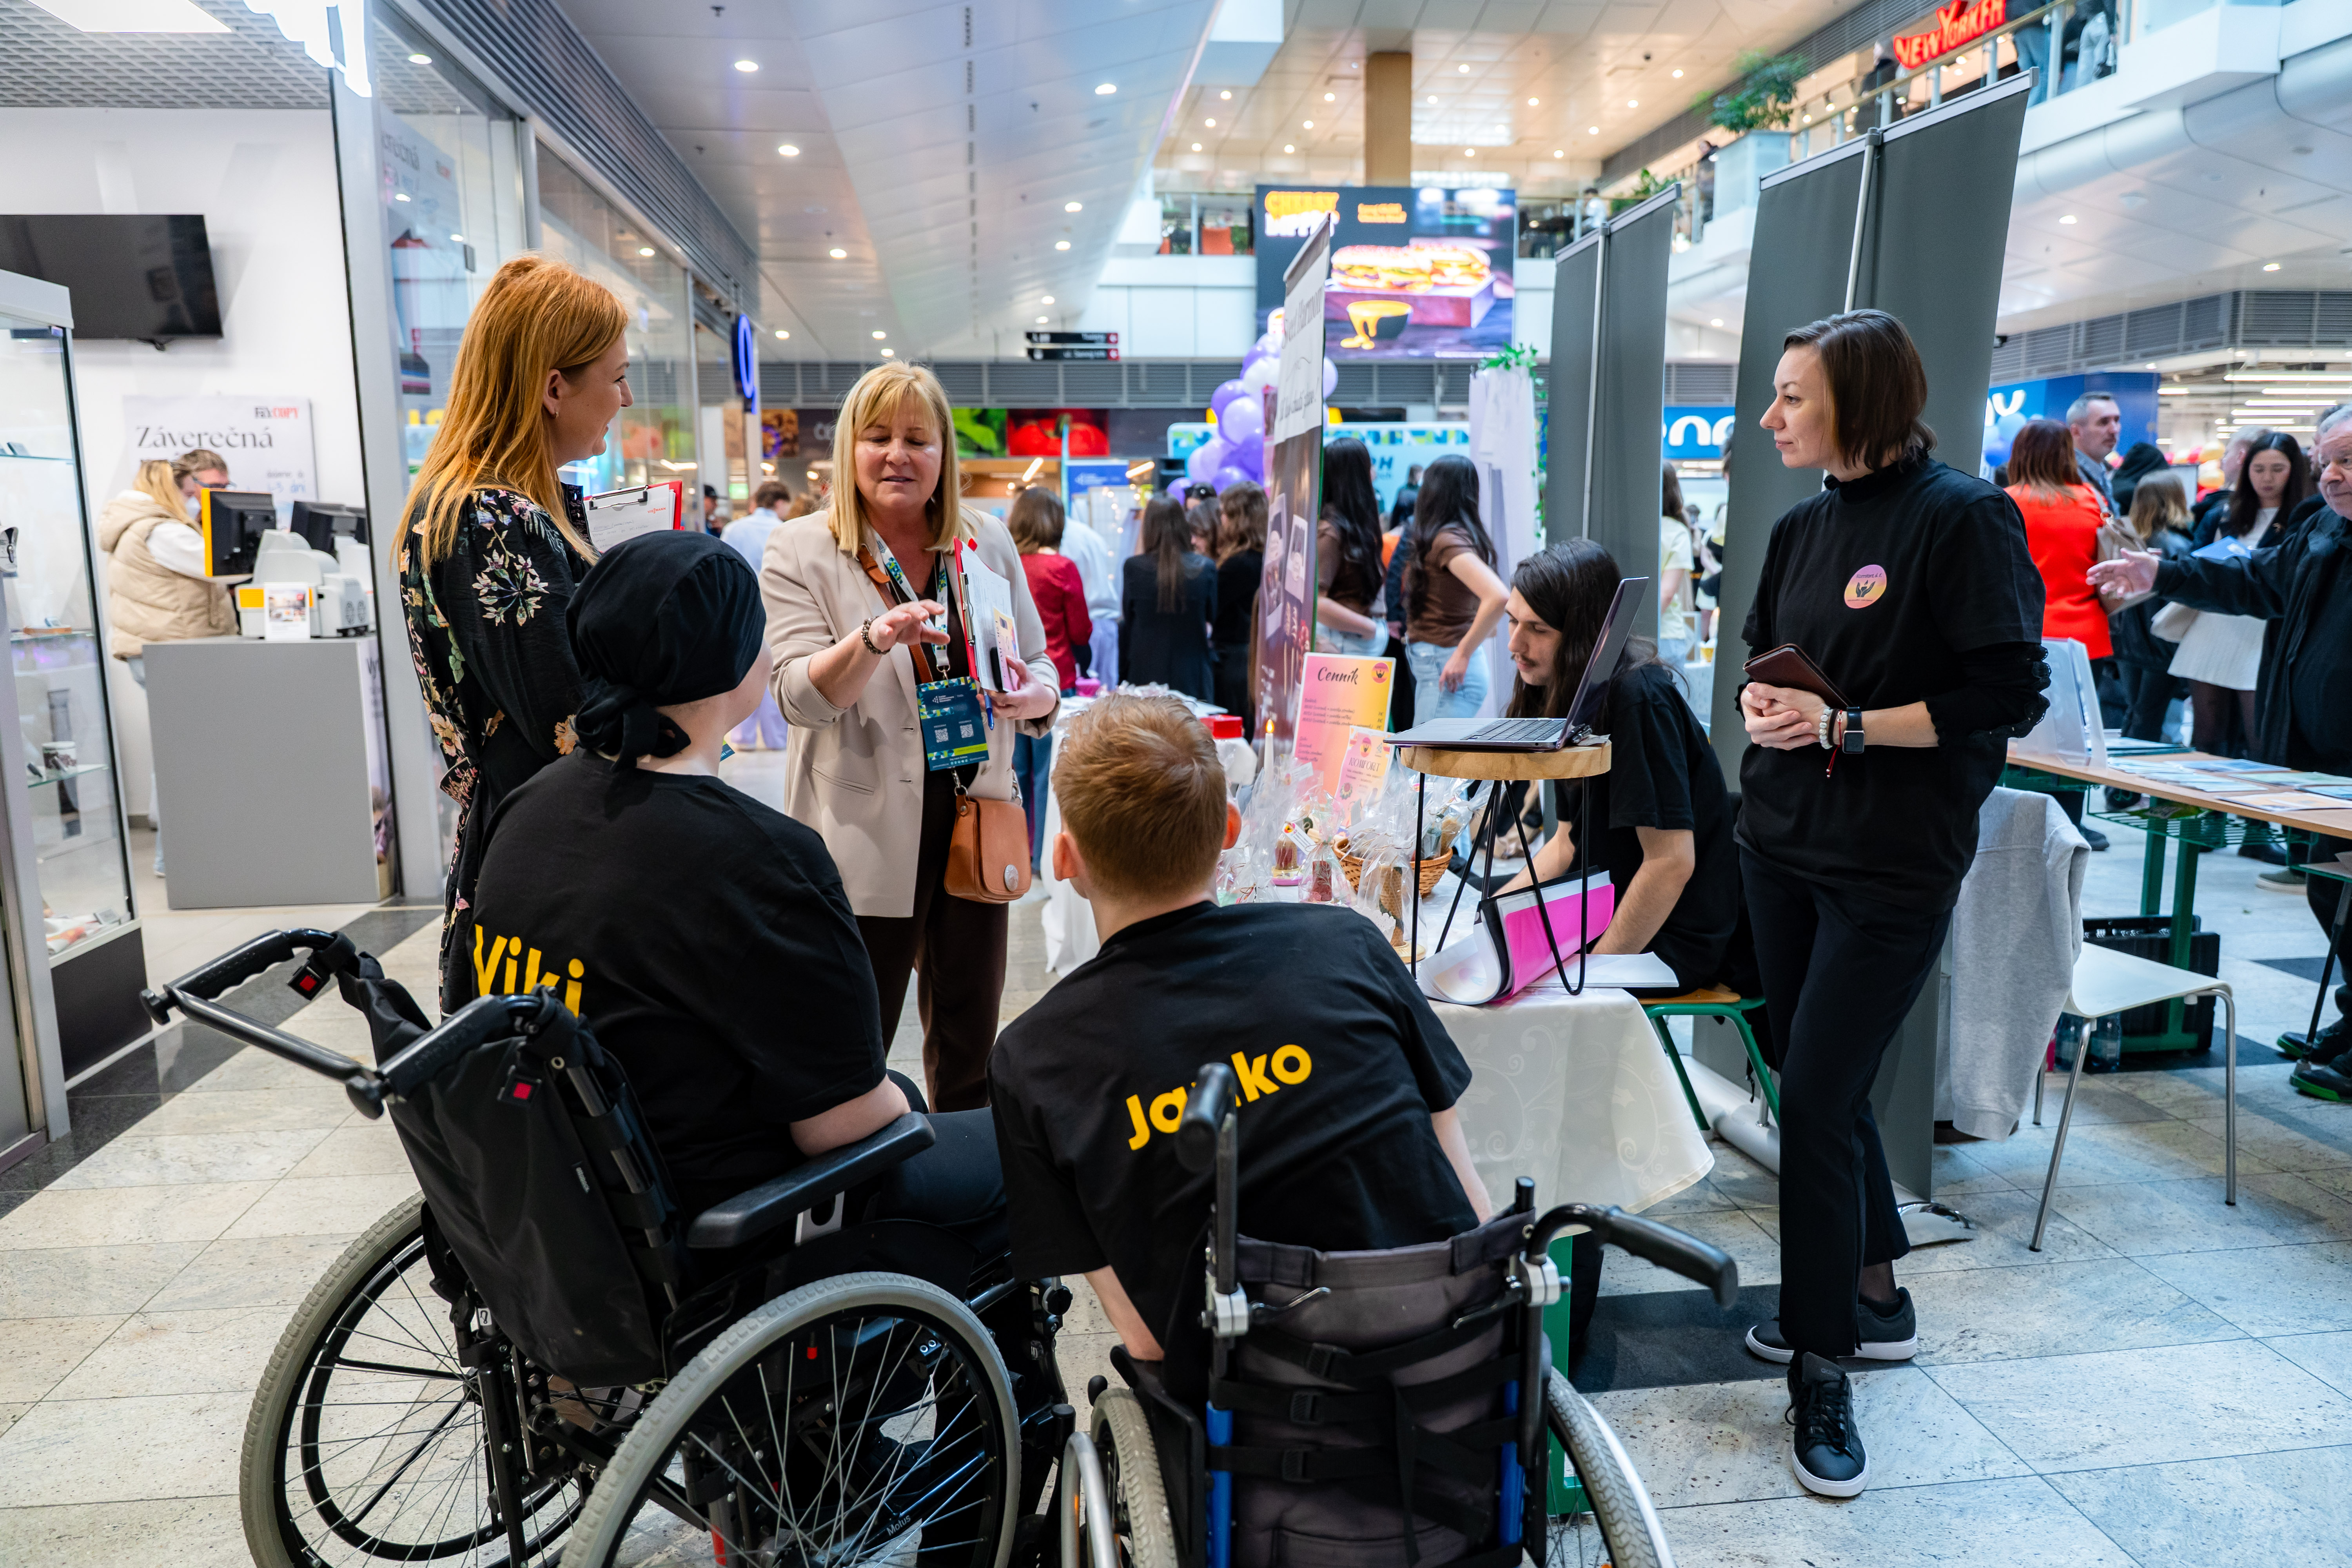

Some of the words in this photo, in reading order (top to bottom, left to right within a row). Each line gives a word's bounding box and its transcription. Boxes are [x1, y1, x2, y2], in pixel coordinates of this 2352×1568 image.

[1893, 29, 1942, 69] NEW
[136, 425, 274, 448] Záverečná
[1318, 667, 1358, 685] Cenník
[1349, 757, 1381, 771] KOMFORT
[474, 924, 584, 1018] Viki
[1126, 1044, 1312, 1151] Jako
[886, 1515, 911, 1536] Motus
